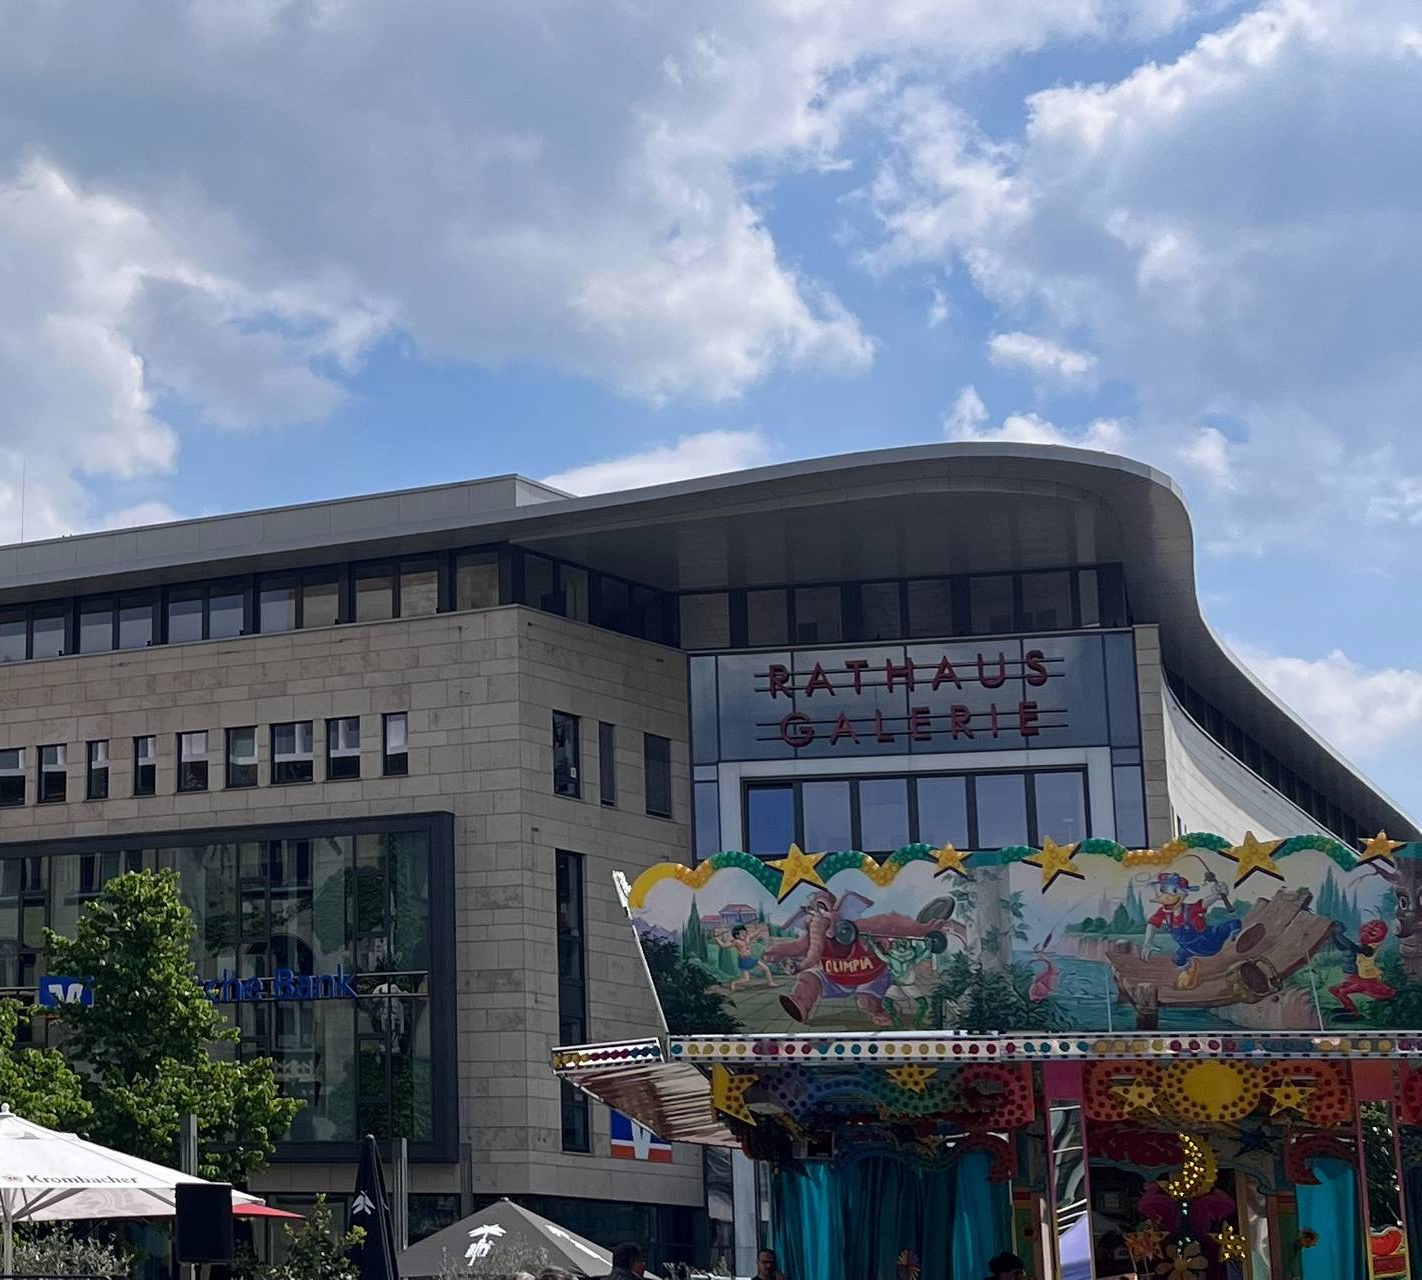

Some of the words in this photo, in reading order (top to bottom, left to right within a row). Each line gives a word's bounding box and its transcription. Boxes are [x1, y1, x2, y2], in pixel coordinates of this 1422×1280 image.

[768, 649, 1049, 699] RATHAUS
[779, 700, 1040, 748] GALERIE
[274, 963, 358, 1001] Bank
[825, 957, 874, 975] OLIMPIA
[26, 1174, 138, 1185] Krombacher
